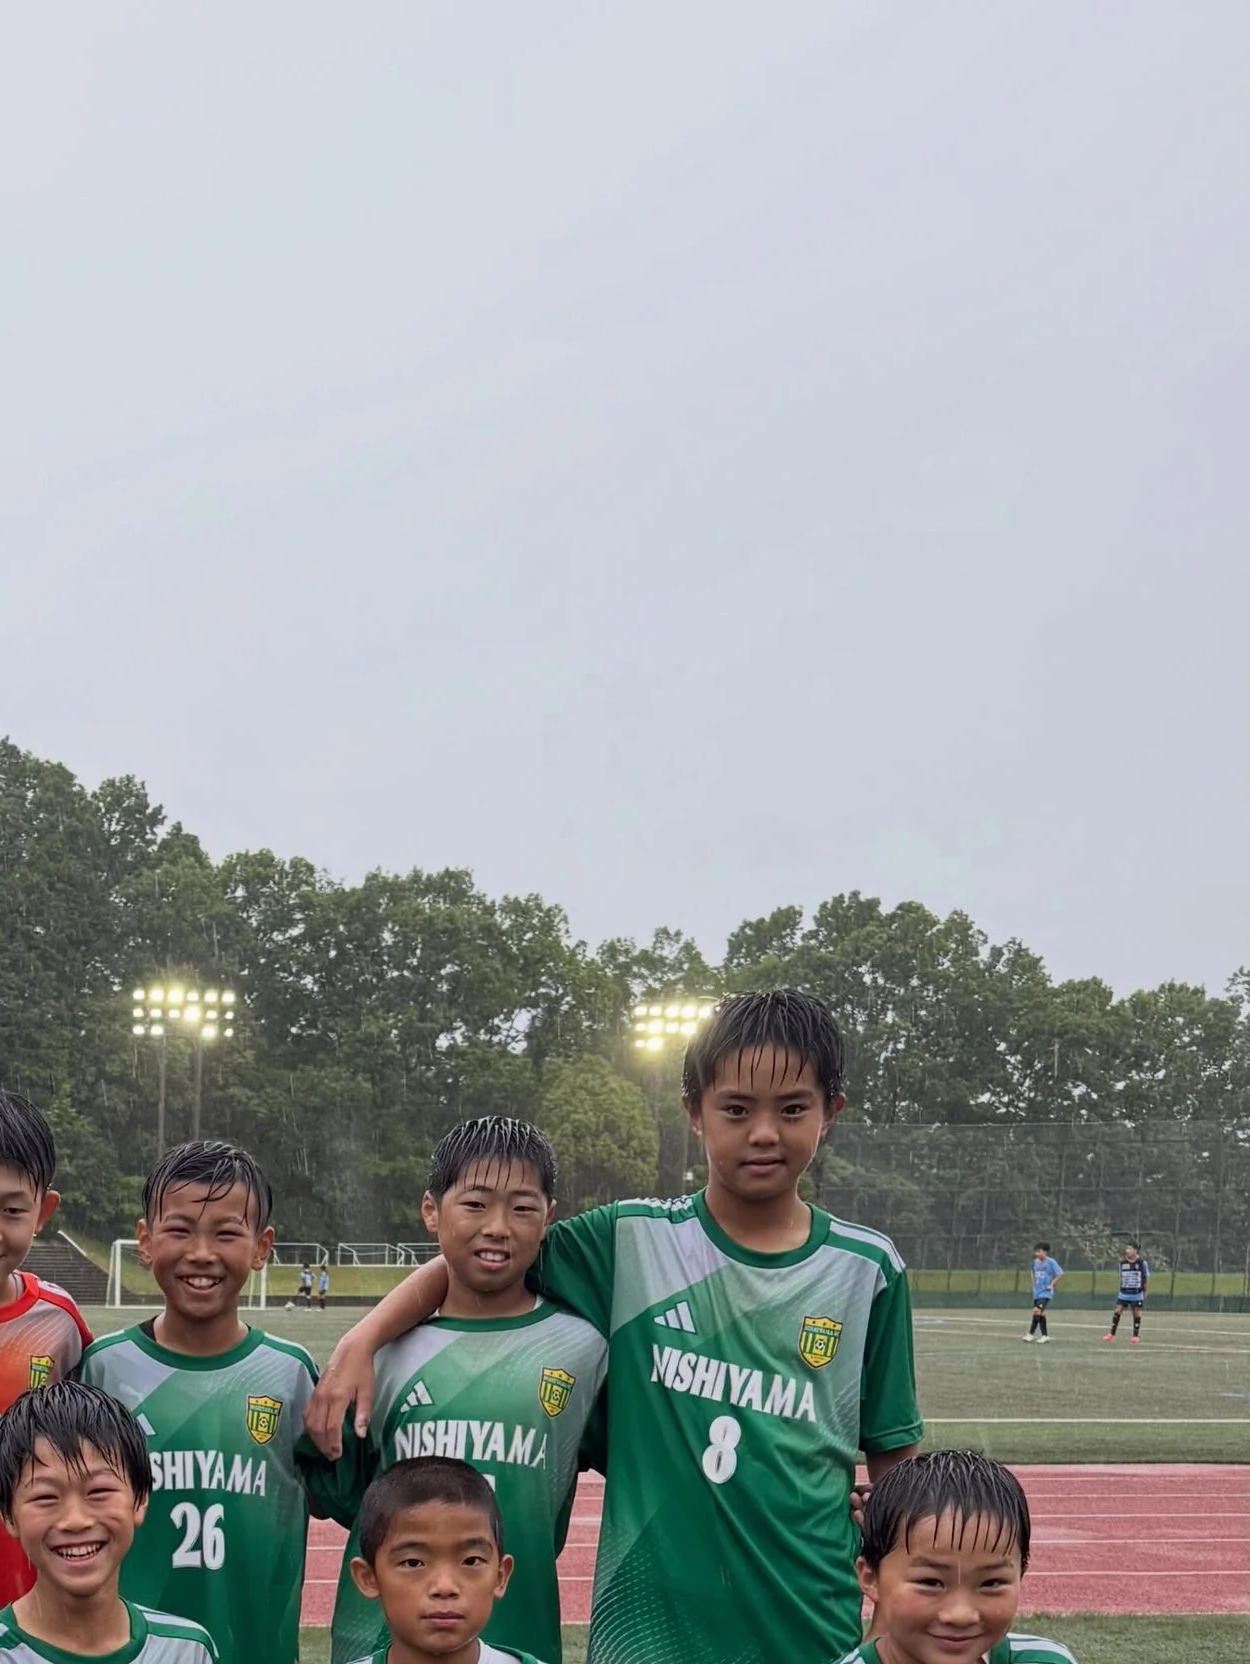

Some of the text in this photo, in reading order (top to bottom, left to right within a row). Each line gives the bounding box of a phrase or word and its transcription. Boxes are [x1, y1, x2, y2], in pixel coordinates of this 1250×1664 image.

[651, 1343, 817, 1422] NISHIYAMA
[149, 1450, 267, 1497] SHIYAMA
[395, 1419, 547, 1470] NISHIYAMA
[702, 1415, 742, 1485] 8
[170, 1501, 226, 1571] 26
